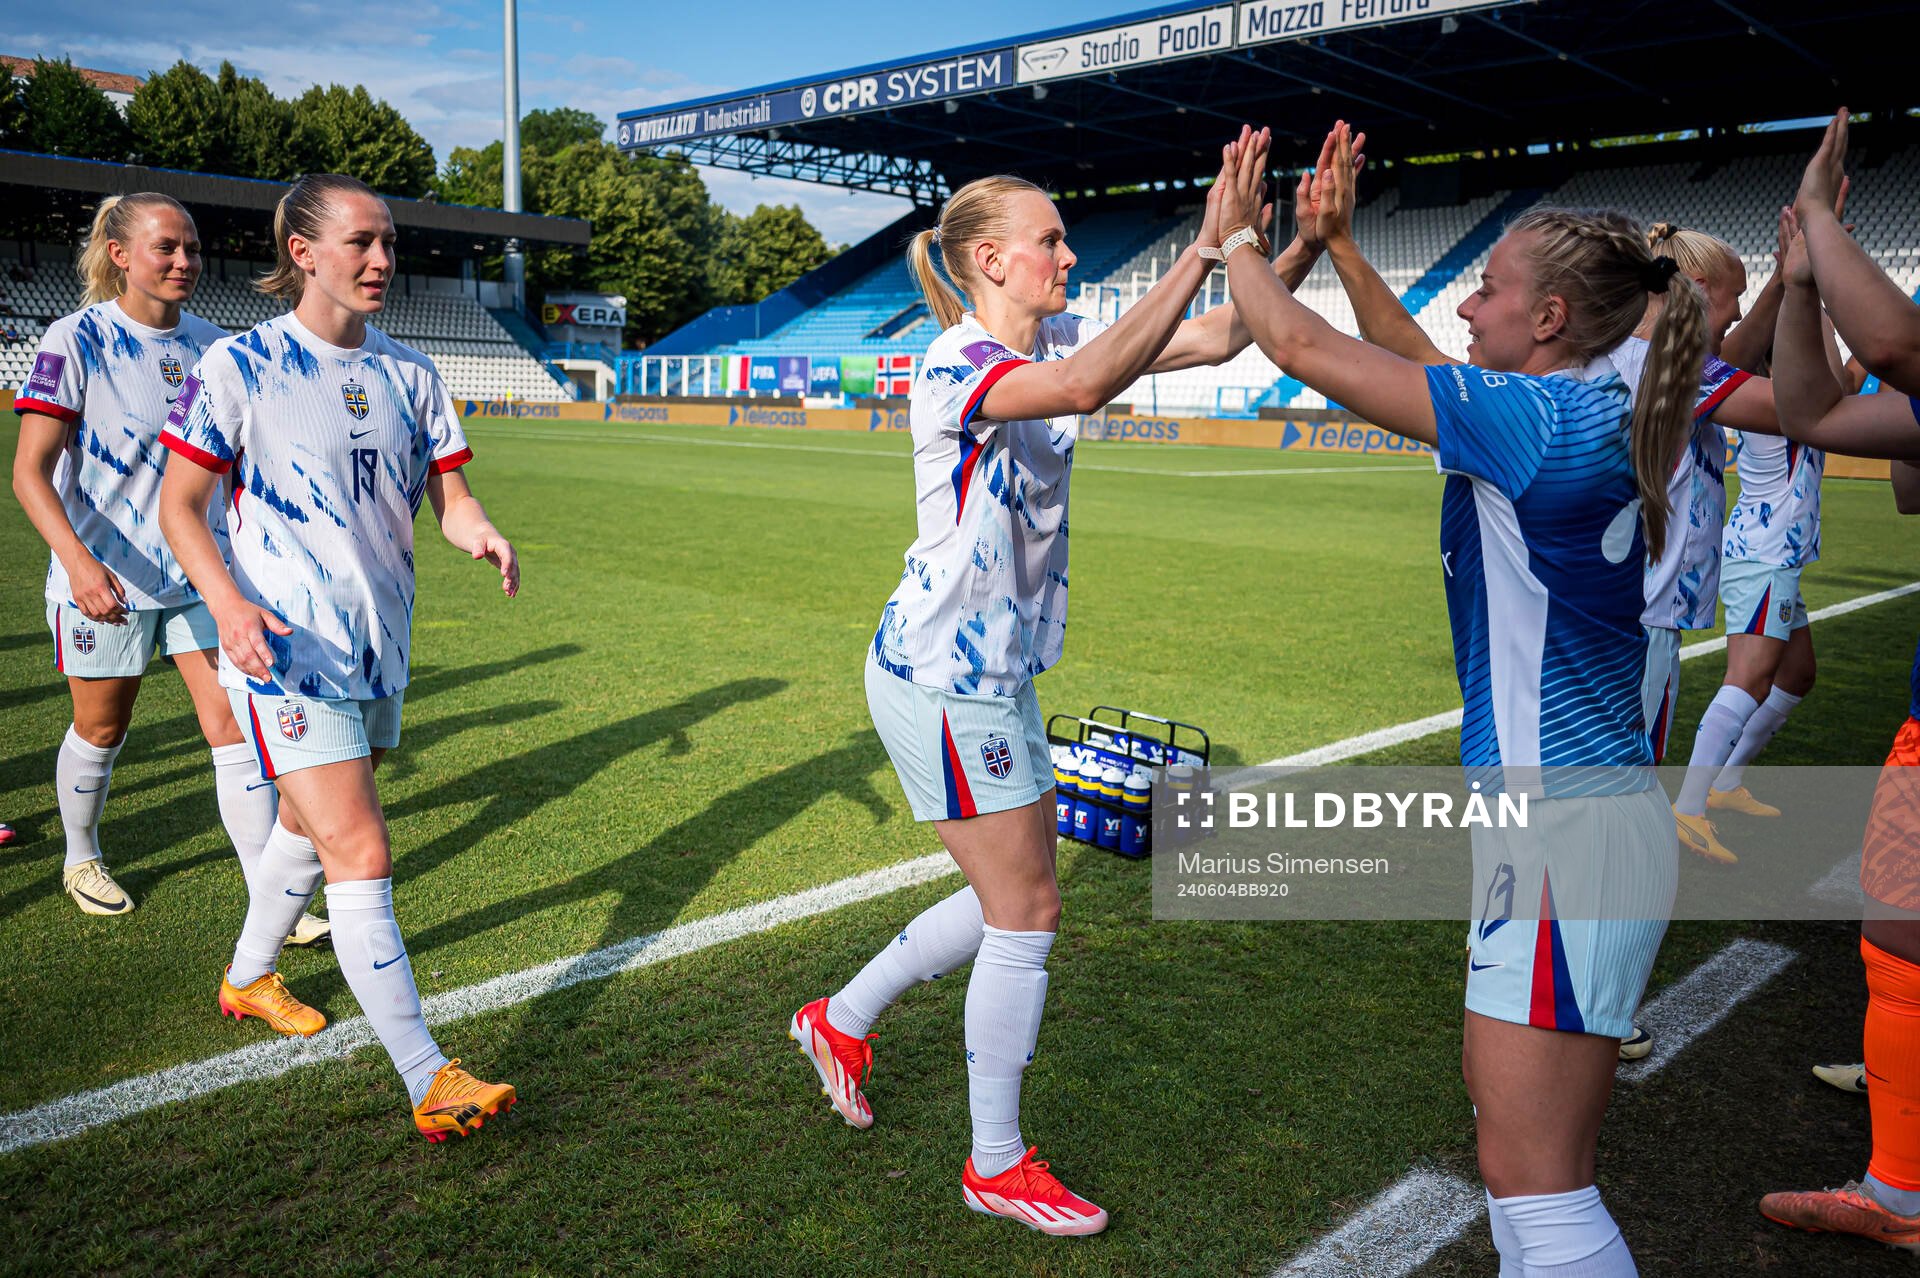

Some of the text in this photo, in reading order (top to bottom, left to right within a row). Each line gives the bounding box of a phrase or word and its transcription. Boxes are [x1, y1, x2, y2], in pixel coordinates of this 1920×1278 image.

[1247, 0, 1325, 40] Mazza
[1081, 15, 1221, 68] Stadio Paolo
[823, 54, 1002, 113] CPR SYSTEM
[703, 99, 772, 132] Industriali
[543, 304, 624, 325] EXERA
[752, 364, 777, 381] FIFA
[482, 400, 560, 420] Telepass
[614, 404, 669, 421] Telepass
[742, 406, 807, 426] Telepass
[349, 448, 378, 505] 19
